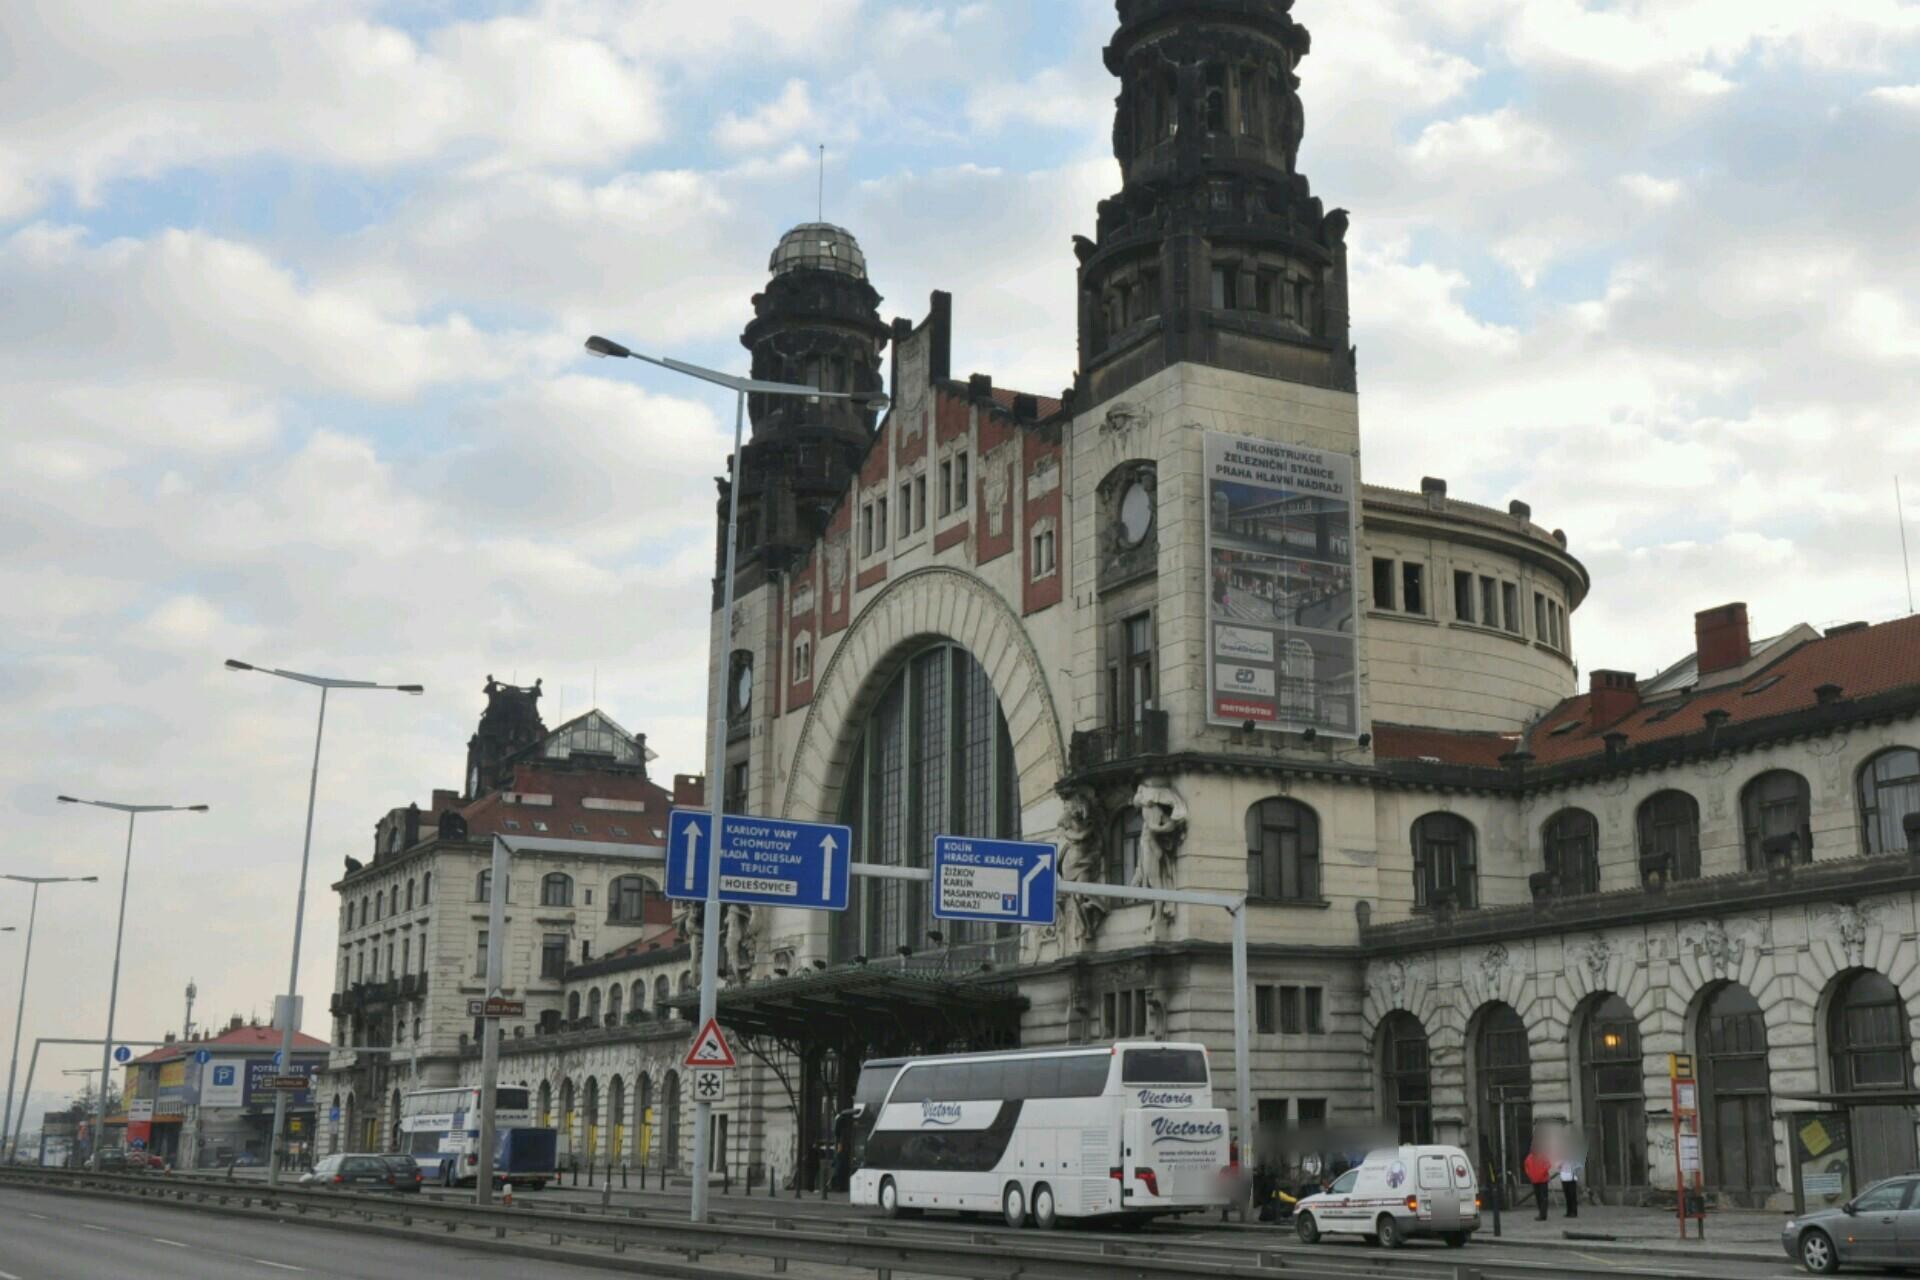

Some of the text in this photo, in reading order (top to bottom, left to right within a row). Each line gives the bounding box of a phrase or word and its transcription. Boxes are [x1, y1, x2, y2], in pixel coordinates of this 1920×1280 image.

[1235, 441, 1323, 464] REKONSTRUKCE
[1223, 450, 1335, 480] ŽELEZNIČNÍ STANICE
[1215, 464, 1344, 494] PRAHA HLAVNÍ NÁDRAŽÍ
[726, 824, 798, 839] KARLOVY VARY
[732, 838, 791, 851] CHOMUTOV
[943, 841, 973, 852] KOLÍN
[754, 853, 802, 865] BOLESLAV
[943, 853, 1025, 866] HRADEC KRÁLOVÉ
[740, 863, 779, 875] TEPLICE
[725, 877, 791, 893] HOLEŠOVICE
[943, 888, 1001, 901] MASARYKOVO
[1137, 1089, 1193, 1104] Victoria
[920, 1096, 961, 1118] Victoria
[1151, 1115, 1223, 1136] Victoria
